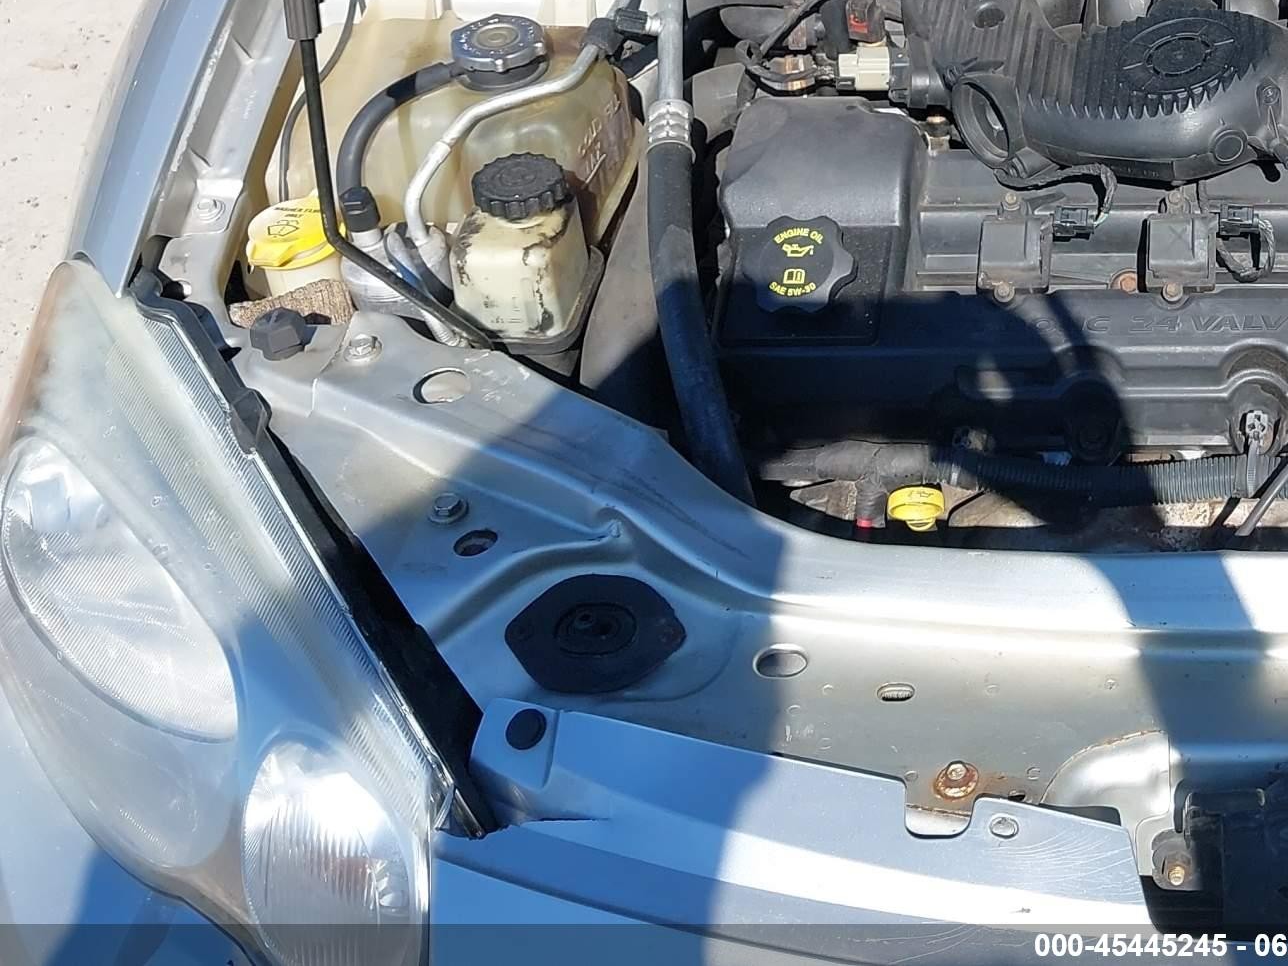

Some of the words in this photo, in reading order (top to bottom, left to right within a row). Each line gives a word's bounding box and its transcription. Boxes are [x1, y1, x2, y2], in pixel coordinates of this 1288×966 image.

[773, 228, 810, 244] ENGINE
[810, 230, 824, 244] OIL
[769, 281, 787, 296] SAE
[787, 282, 817, 296] 5W-30
[1128, 314, 1182, 333] 24
